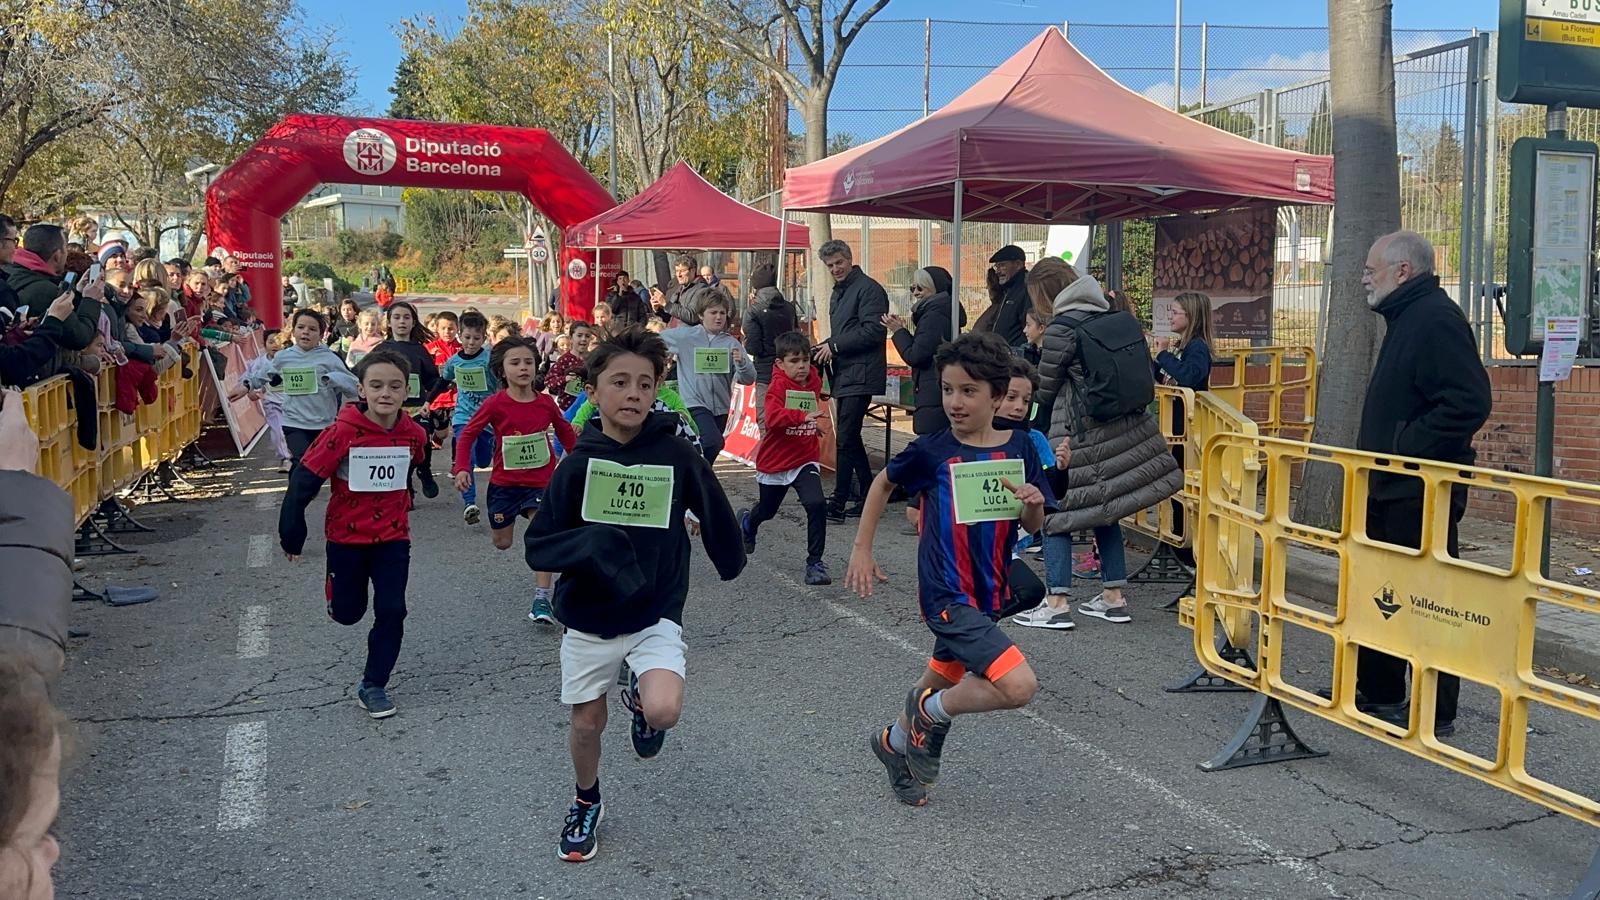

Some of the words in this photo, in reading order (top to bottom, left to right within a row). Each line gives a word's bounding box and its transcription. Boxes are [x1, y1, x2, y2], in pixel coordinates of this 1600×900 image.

[1526, 24, 1540, 36] L4
[1570, 24, 1595, 34] Floresta
[1561, 34, 1576, 42] (Bus
[1577, 36, 1594, 44] Barri)
[406, 137, 502, 157] Diputació
[406, 158, 501, 176] Barcelona
[233, 250, 274, 260] Diputació
[237, 260, 274, 268] arcelona
[799, 401, 810, 410] 432
[520, 445, 535, 454] 411
[369, 465, 395, 480] 700
[617, 481, 644, 498] 410
[610, 498, 646, 510] LUCAS
[983, 496, 1008, 505] LUCA
[1410, 594, 1490, 626] Valldoreix-EMD
[1411, 608, 1431, 619] Entitat
[1432, 615, 1462, 628] Municipal
